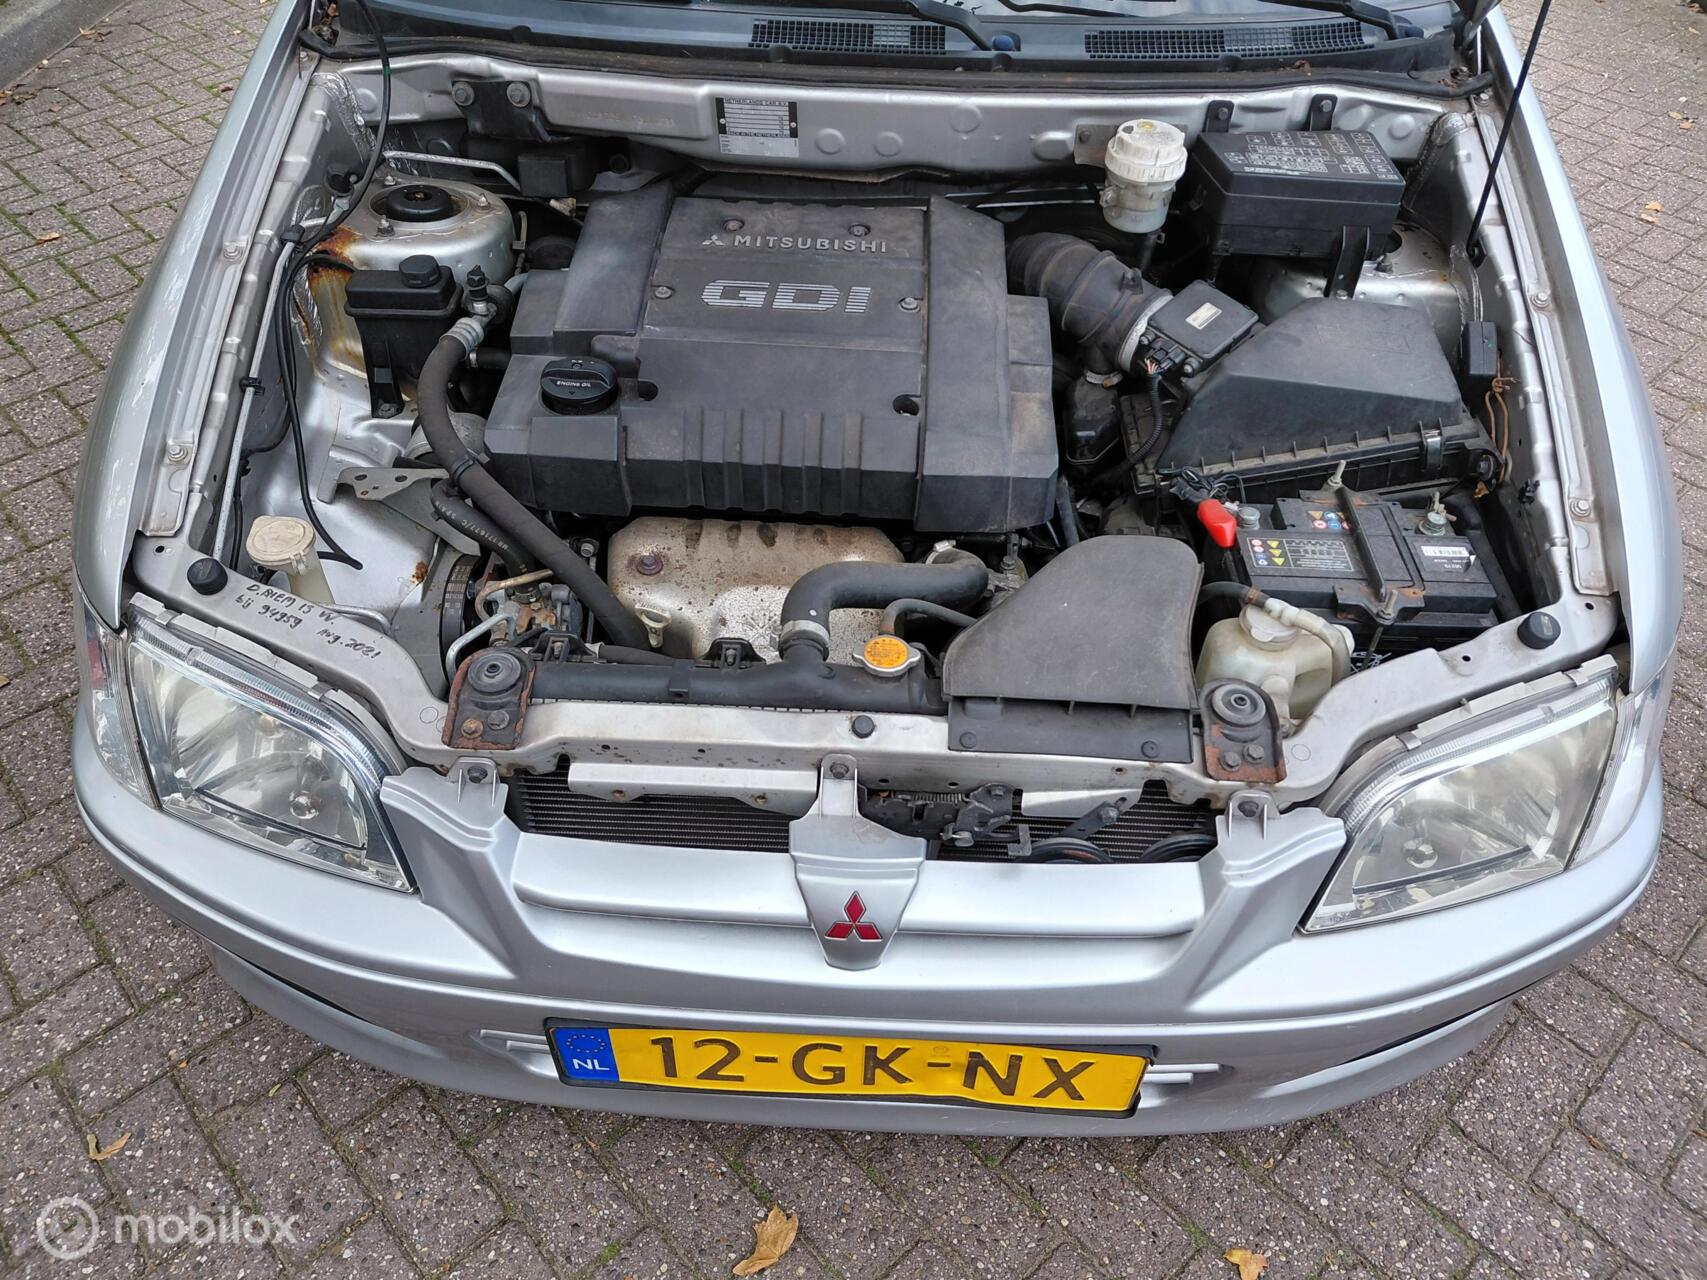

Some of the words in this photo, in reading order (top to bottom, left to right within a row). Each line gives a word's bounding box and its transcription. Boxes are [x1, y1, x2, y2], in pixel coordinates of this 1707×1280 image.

[734, 235, 887, 252] MITSUBISHI
[701, 280, 871, 313] GDI
[572, 1056, 610, 1072] NL
[650, 1036, 1096, 1101] 12-GK-NX
